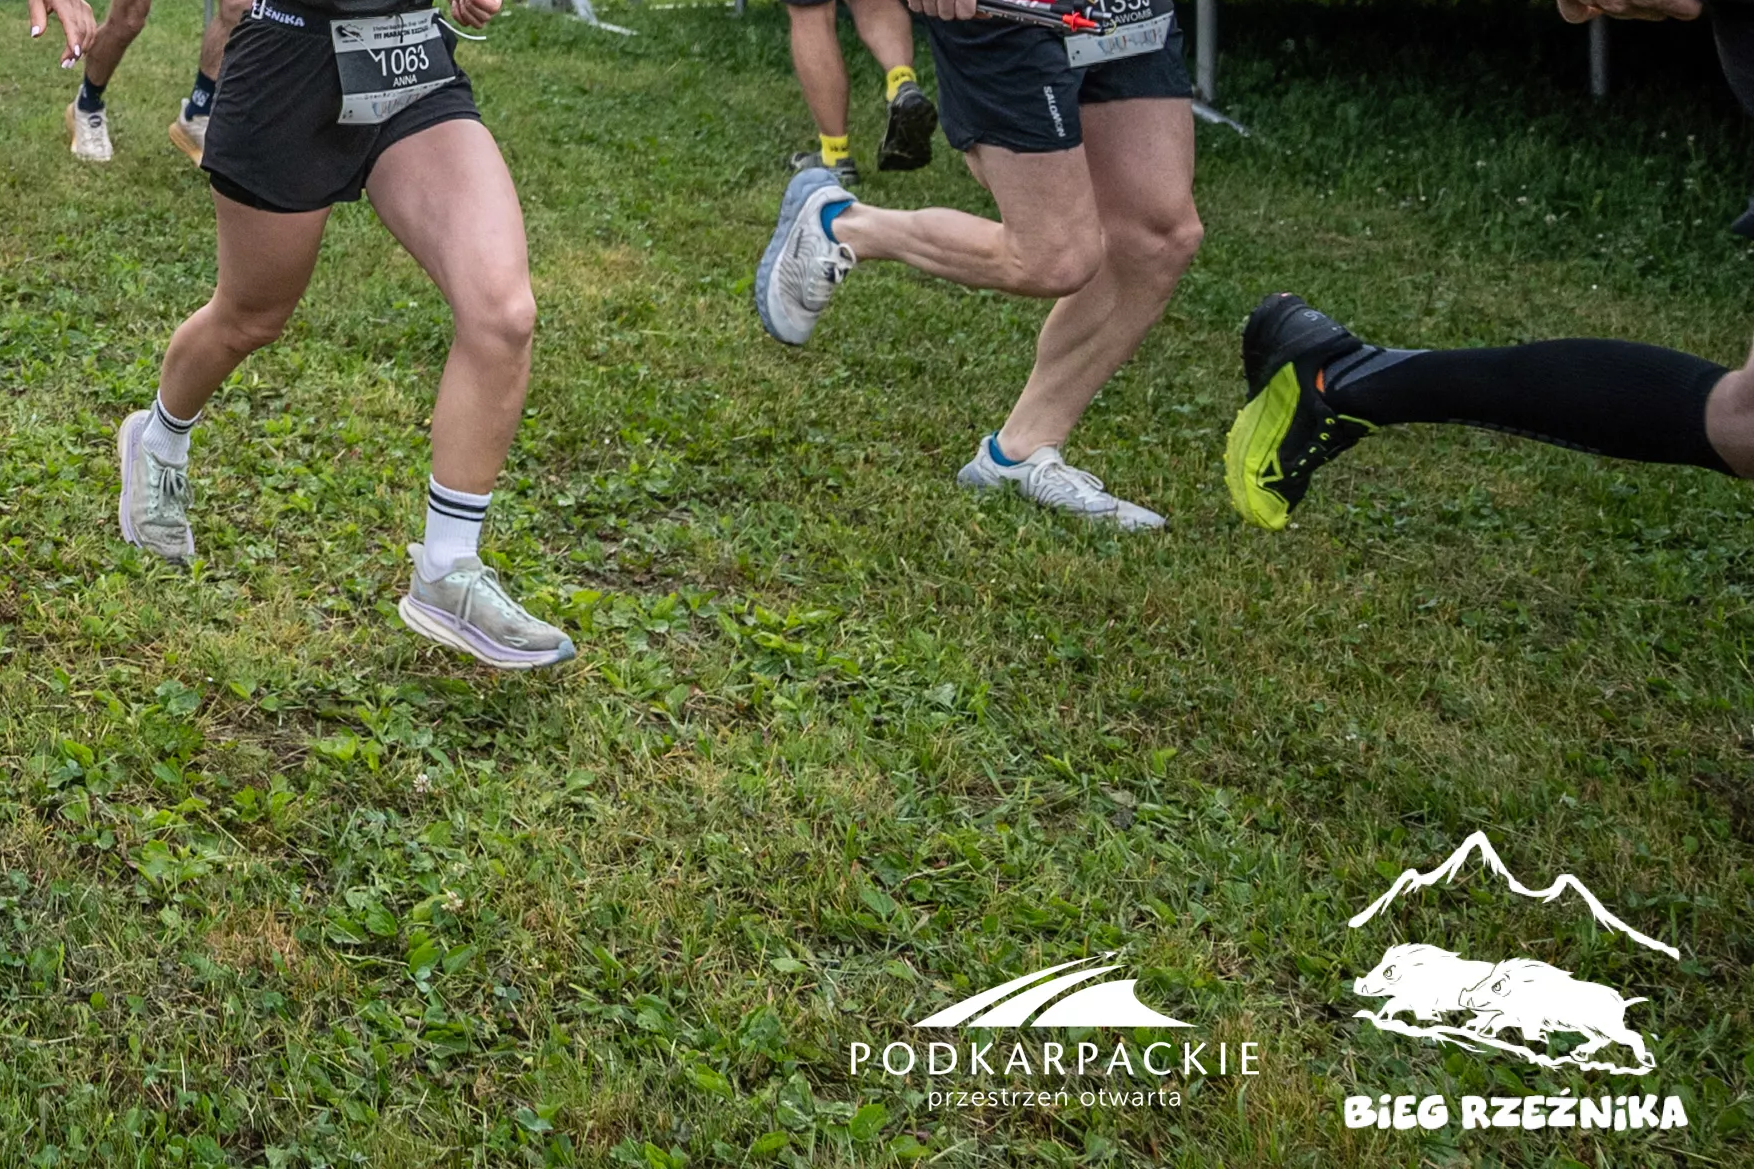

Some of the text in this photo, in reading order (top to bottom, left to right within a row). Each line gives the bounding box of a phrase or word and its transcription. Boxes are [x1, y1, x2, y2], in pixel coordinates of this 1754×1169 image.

[377, 44, 430, 76] 1063
[393, 74, 418, 88] ANNA
[1043, 85, 1067, 138] SALOMON
